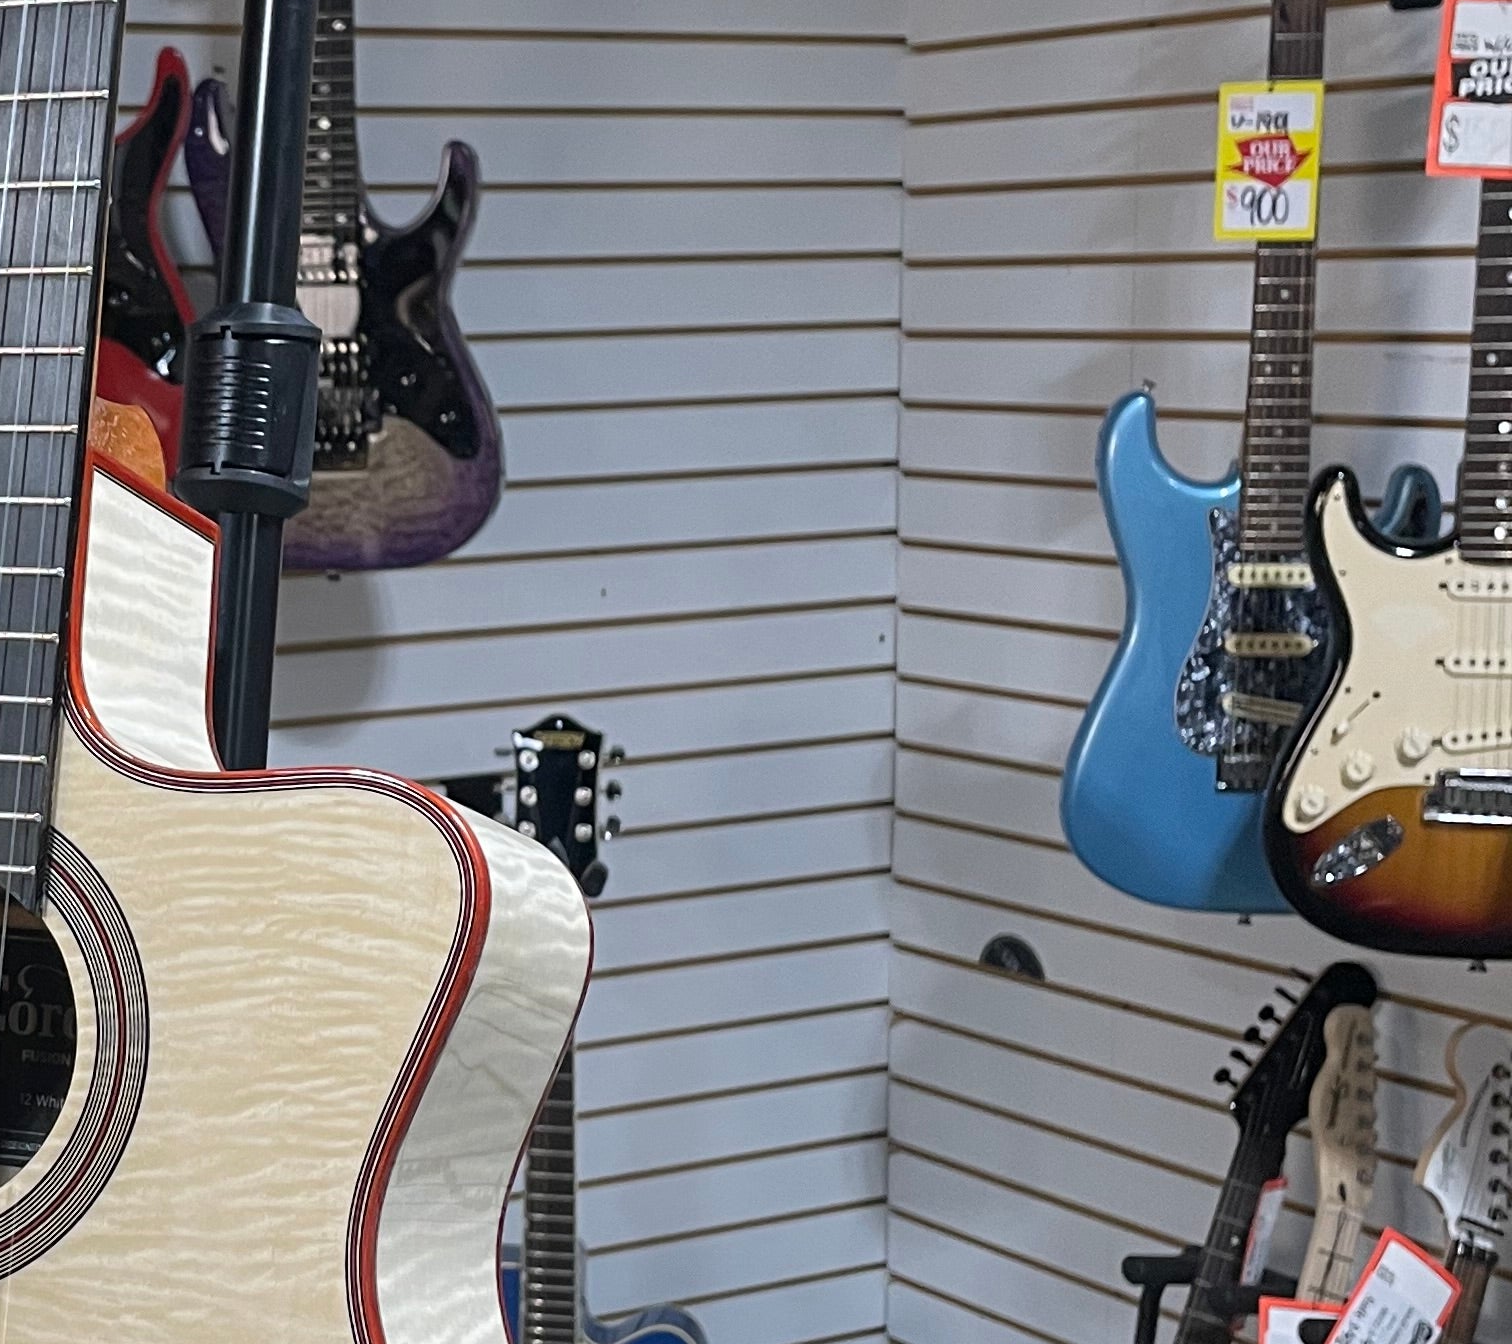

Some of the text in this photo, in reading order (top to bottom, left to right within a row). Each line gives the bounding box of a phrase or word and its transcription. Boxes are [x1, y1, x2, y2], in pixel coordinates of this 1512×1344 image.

[1469, 58, 1512, 78] OU
[1249, 138, 1291, 158] OUR
[1243, 154, 1298, 174] PRICE
